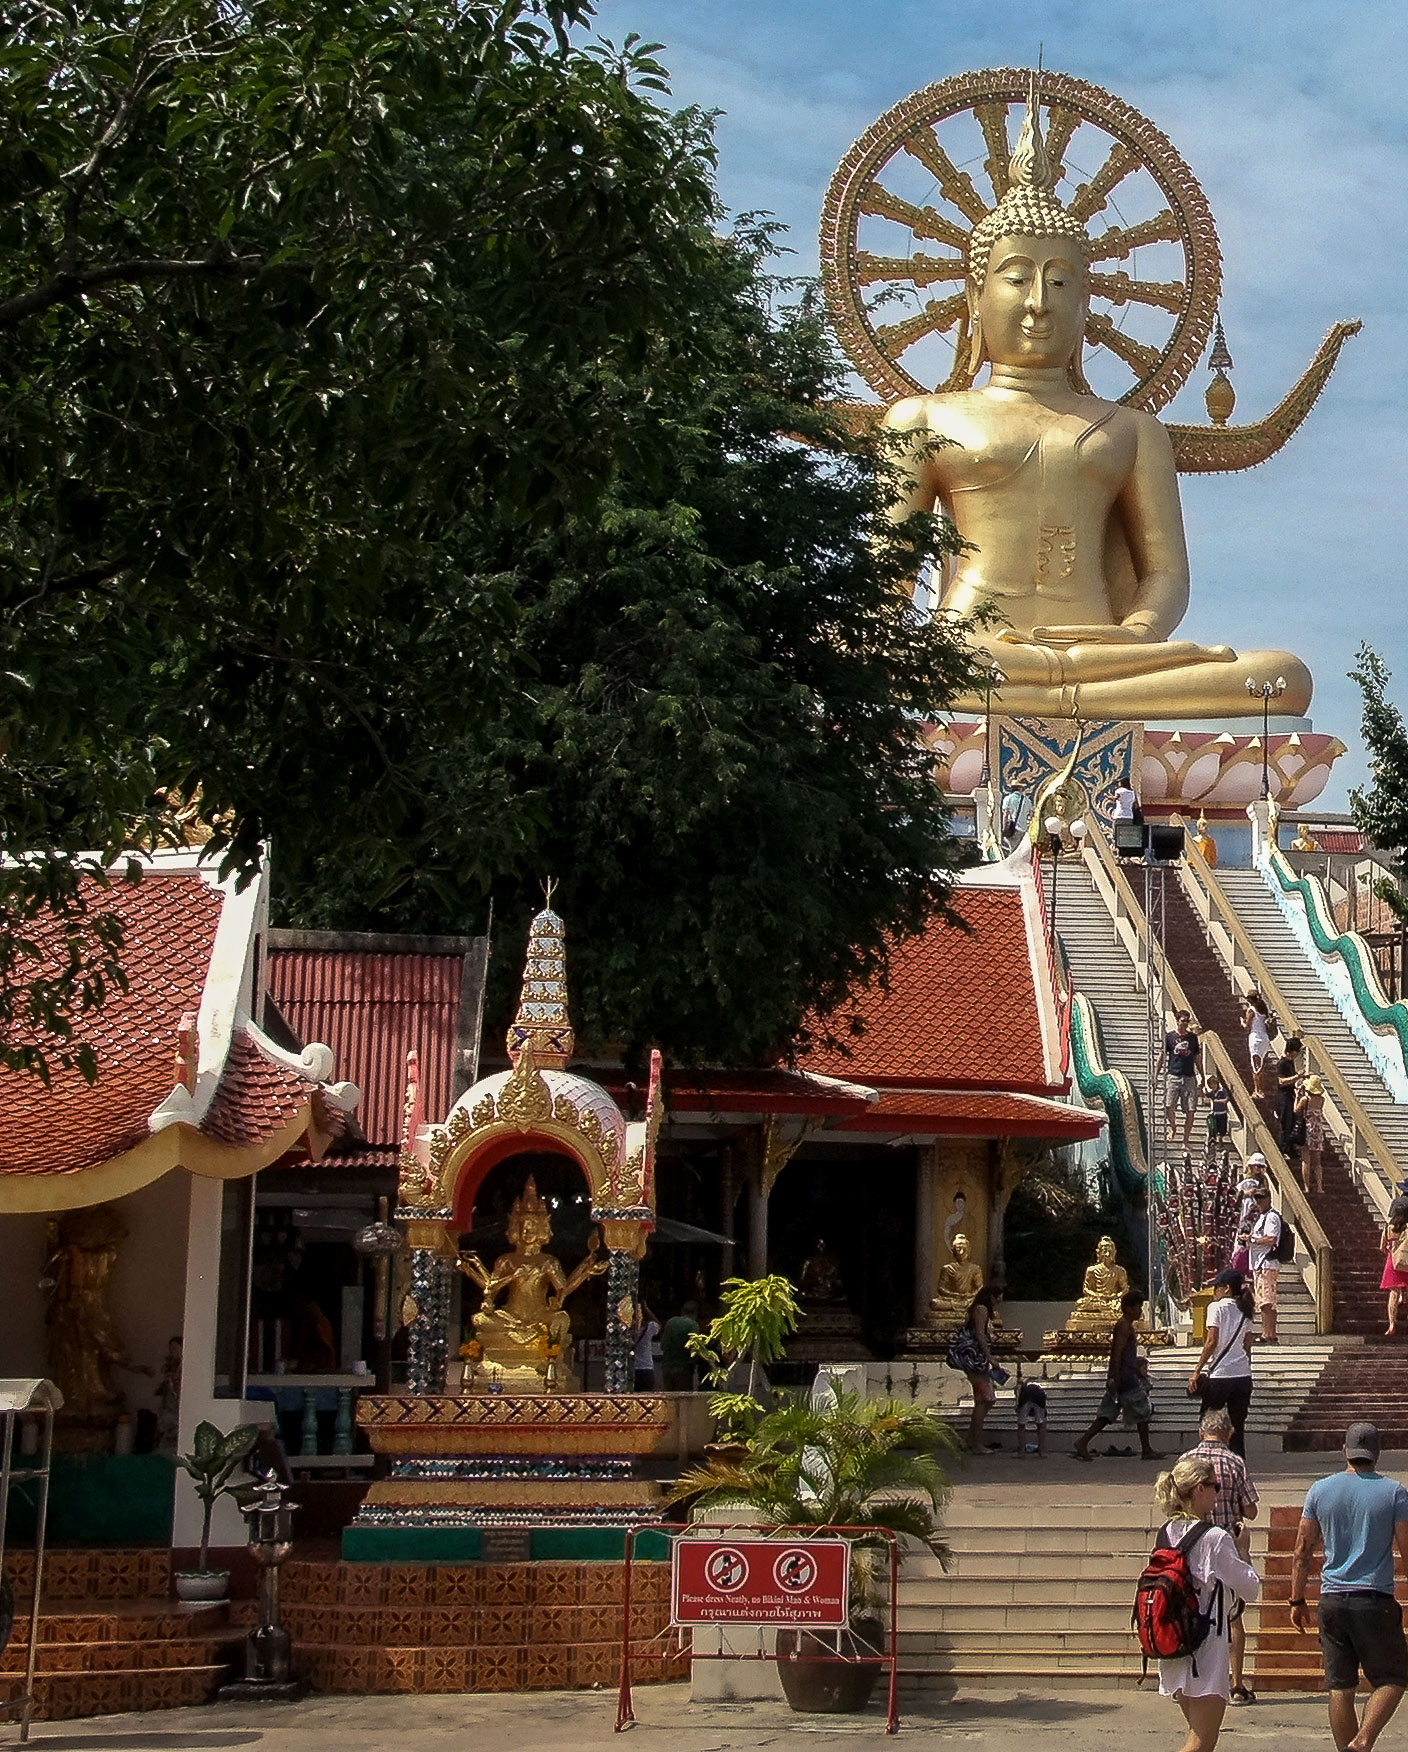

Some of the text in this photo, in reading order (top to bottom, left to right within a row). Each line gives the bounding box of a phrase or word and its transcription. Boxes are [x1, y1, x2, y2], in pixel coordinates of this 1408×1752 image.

[682, 1593, 704, 1603] Please
[705, 1594, 724, 1603] dress
[725, 1594, 750, 1606] Neatly,
[762, 1595, 783, 1604] Bikini
[803, 1595, 810, 1604] &
[700, 1605, 822, 1622] กรุณาแต่งกายให้สุภาพ
